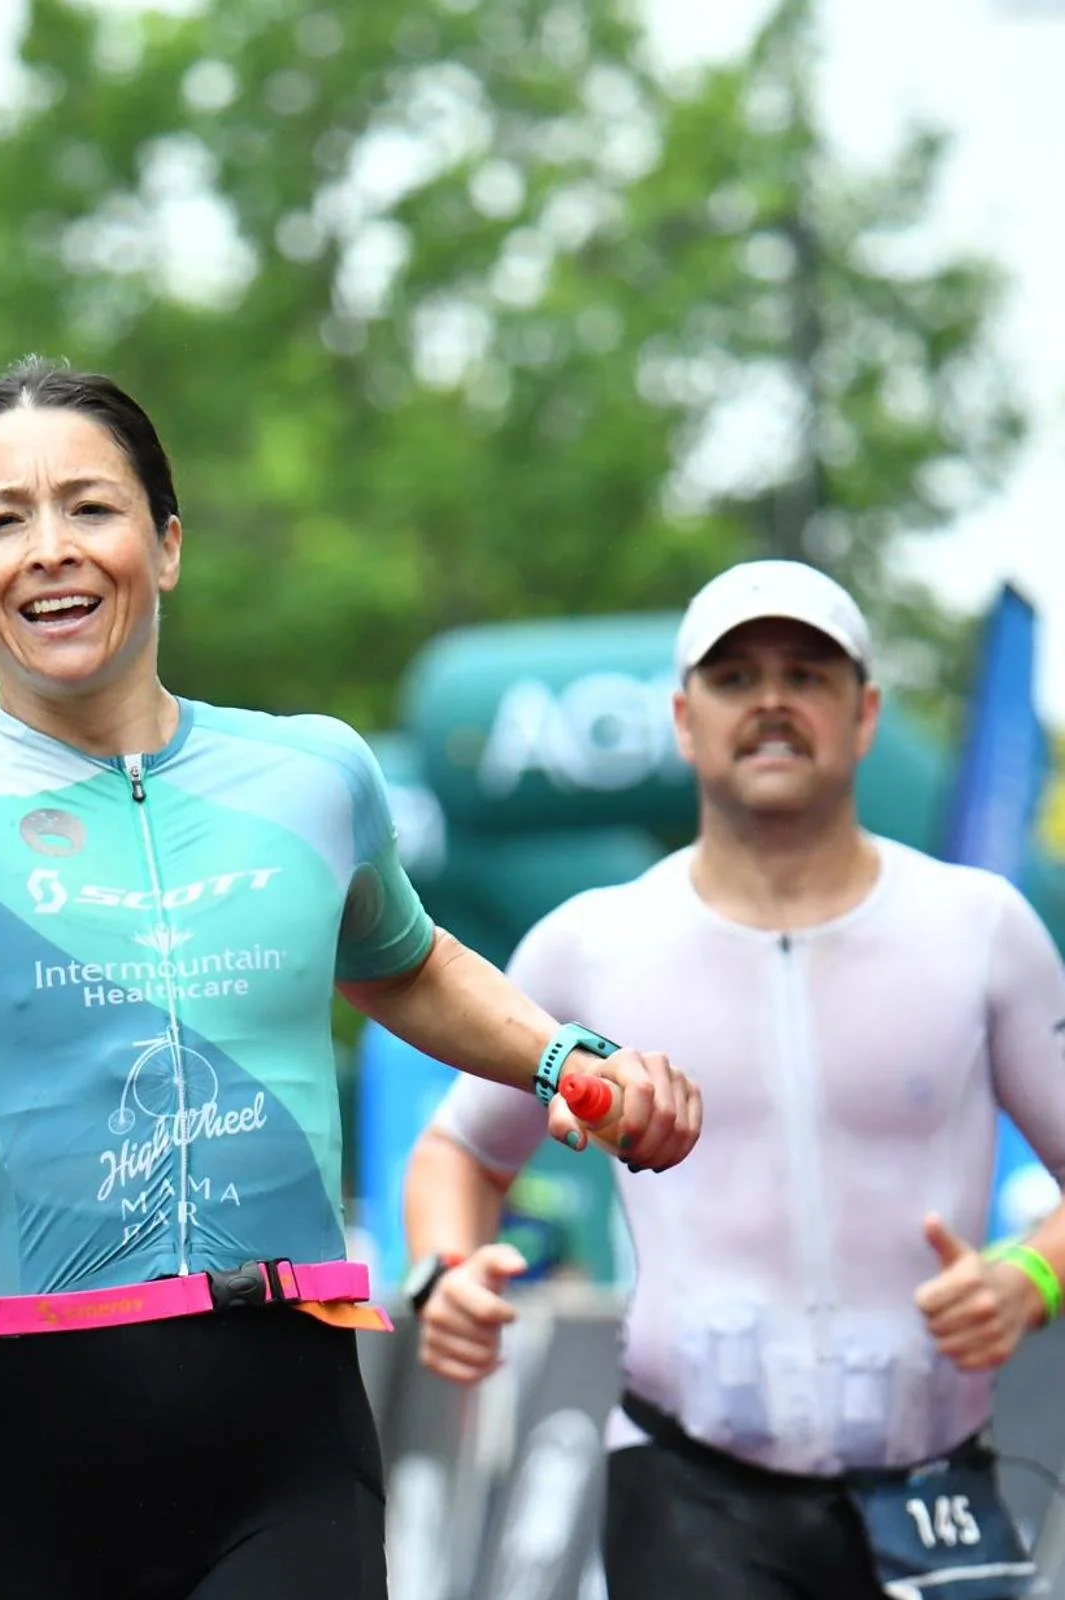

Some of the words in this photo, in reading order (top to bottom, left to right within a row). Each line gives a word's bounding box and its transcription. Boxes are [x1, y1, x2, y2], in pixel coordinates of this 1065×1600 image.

[75, 867, 283, 911] SCOTT
[34, 943, 282, 990] Intermountain
[83, 976, 250, 1008] Healthcare
[121, 1173, 241, 1222] MAMA
[905, 1494, 982, 1550] 145
